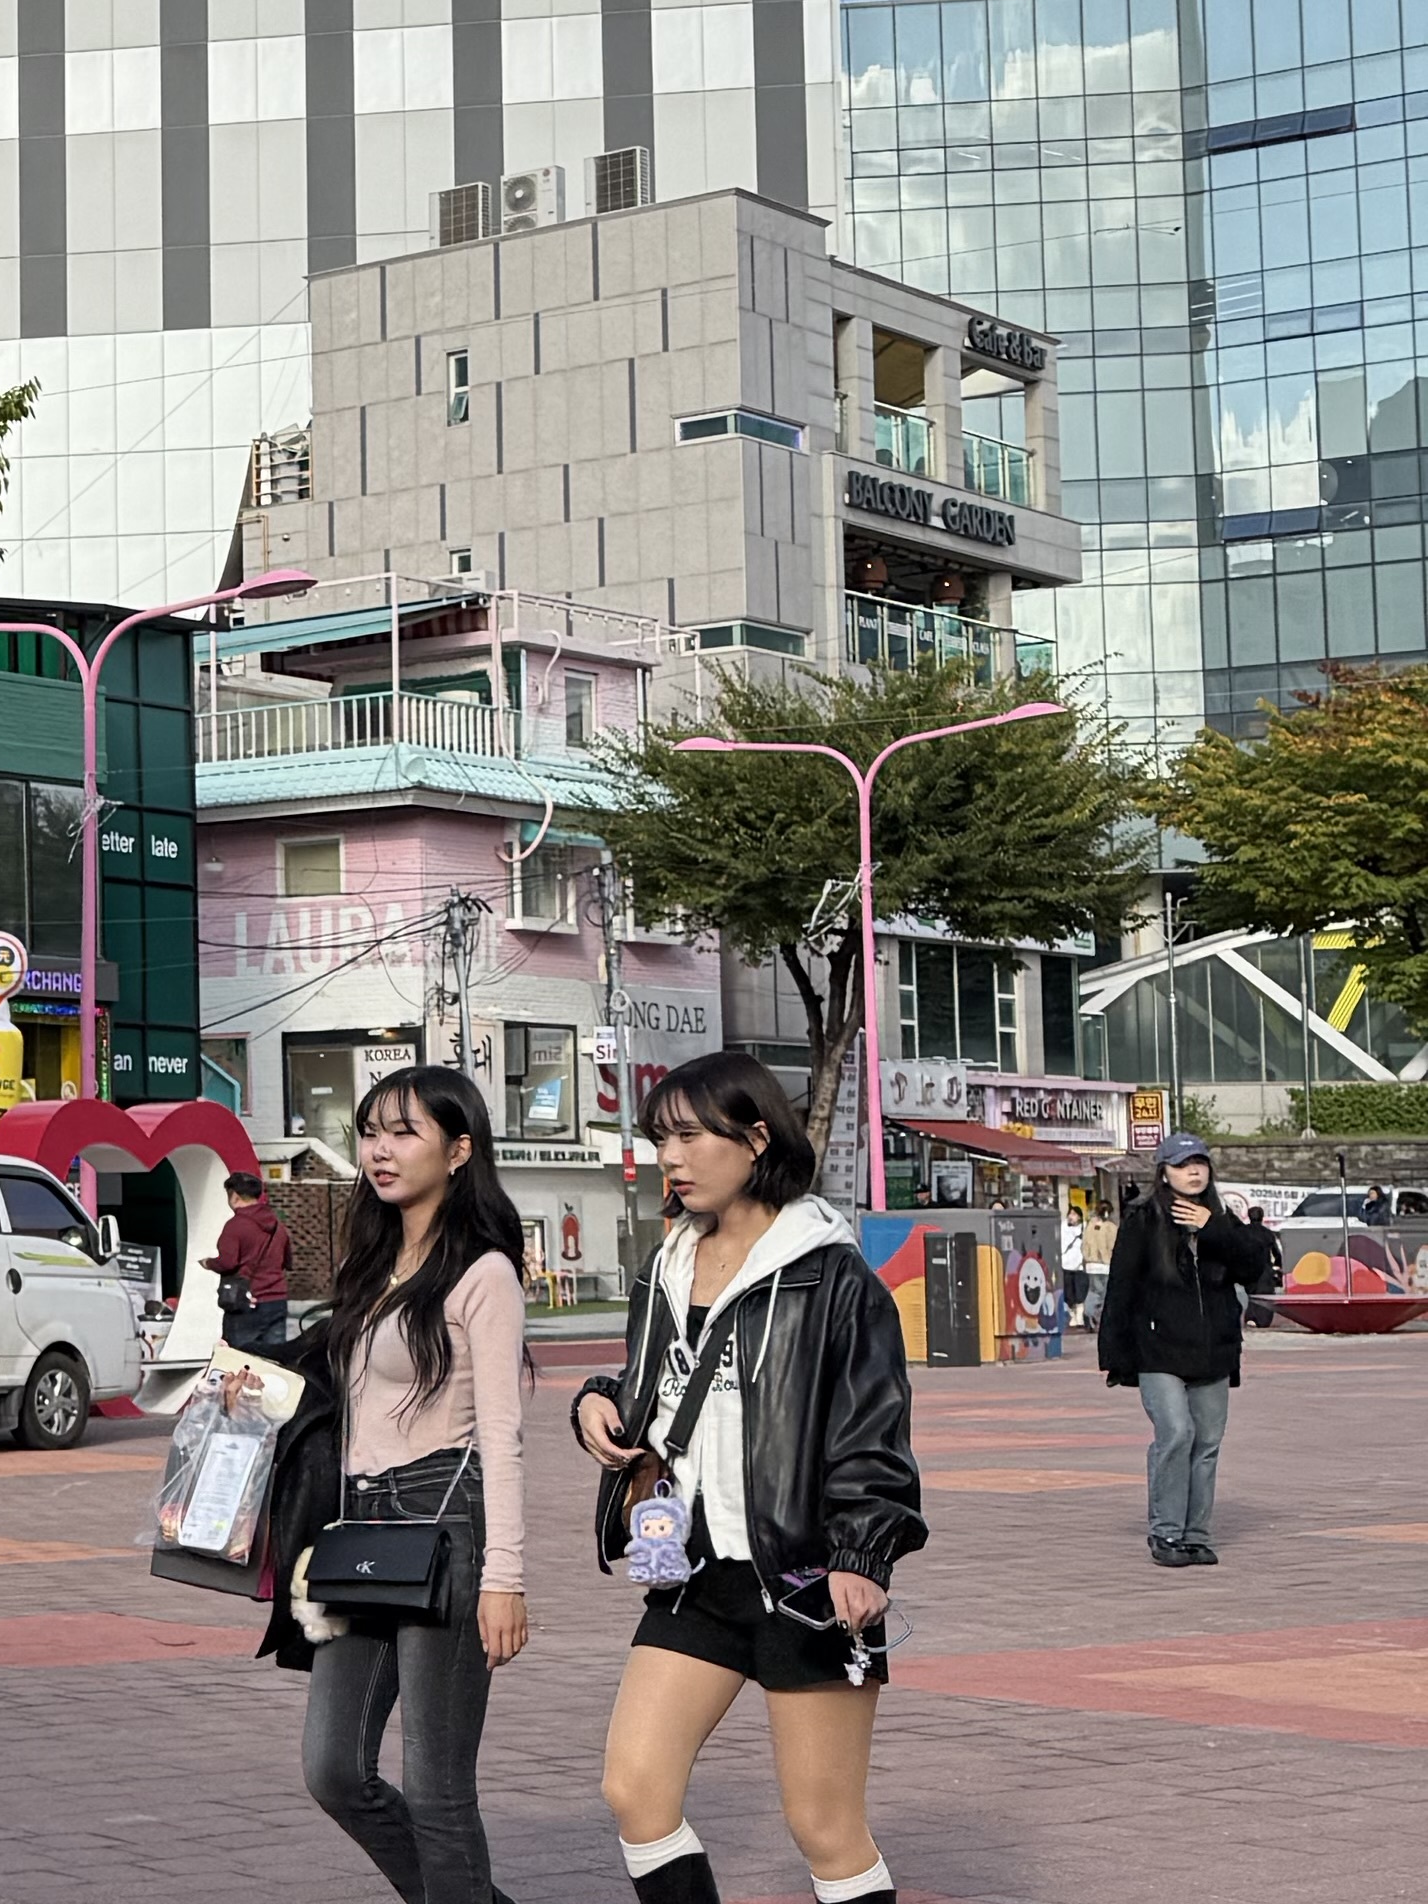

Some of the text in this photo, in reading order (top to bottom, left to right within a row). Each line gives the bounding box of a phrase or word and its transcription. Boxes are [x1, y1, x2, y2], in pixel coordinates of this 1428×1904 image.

[968, 316, 1005, 356] Cafe
[848, 471, 1015, 545] BALCONY GARDEN
[151, 835, 178, 858] late
[235, 903, 413, 977] LAURA
[666, 1005, 707, 1033] DAE
[364, 1049, 411, 1062] KOREA
[596, 1044, 617, 1059] Si
[114, 1055, 188, 1073] an never
[1016, 1098, 1038, 1117] RED
